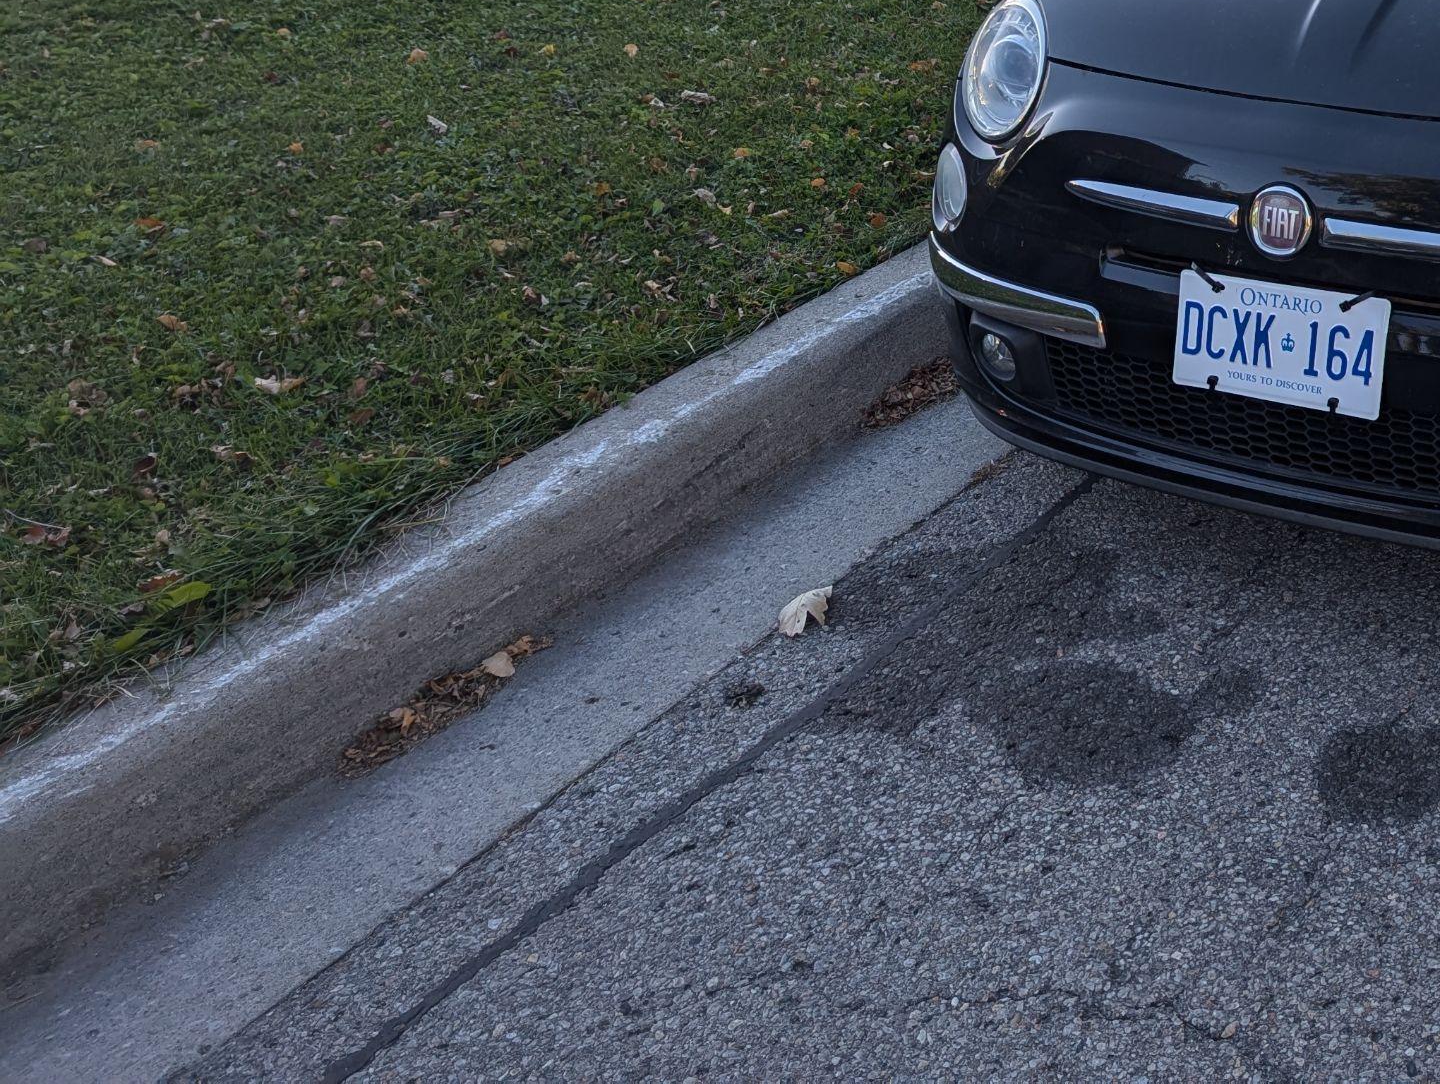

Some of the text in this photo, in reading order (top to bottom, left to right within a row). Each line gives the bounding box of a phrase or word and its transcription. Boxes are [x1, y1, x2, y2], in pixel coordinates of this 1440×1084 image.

[1262, 205, 1300, 240] FIAT
[1240, 287, 1322, 315] ONTARIO
[1182, 300, 1374, 386] DCXK 164
[1227, 369, 1322, 395] YOURS TO DISCOVER
